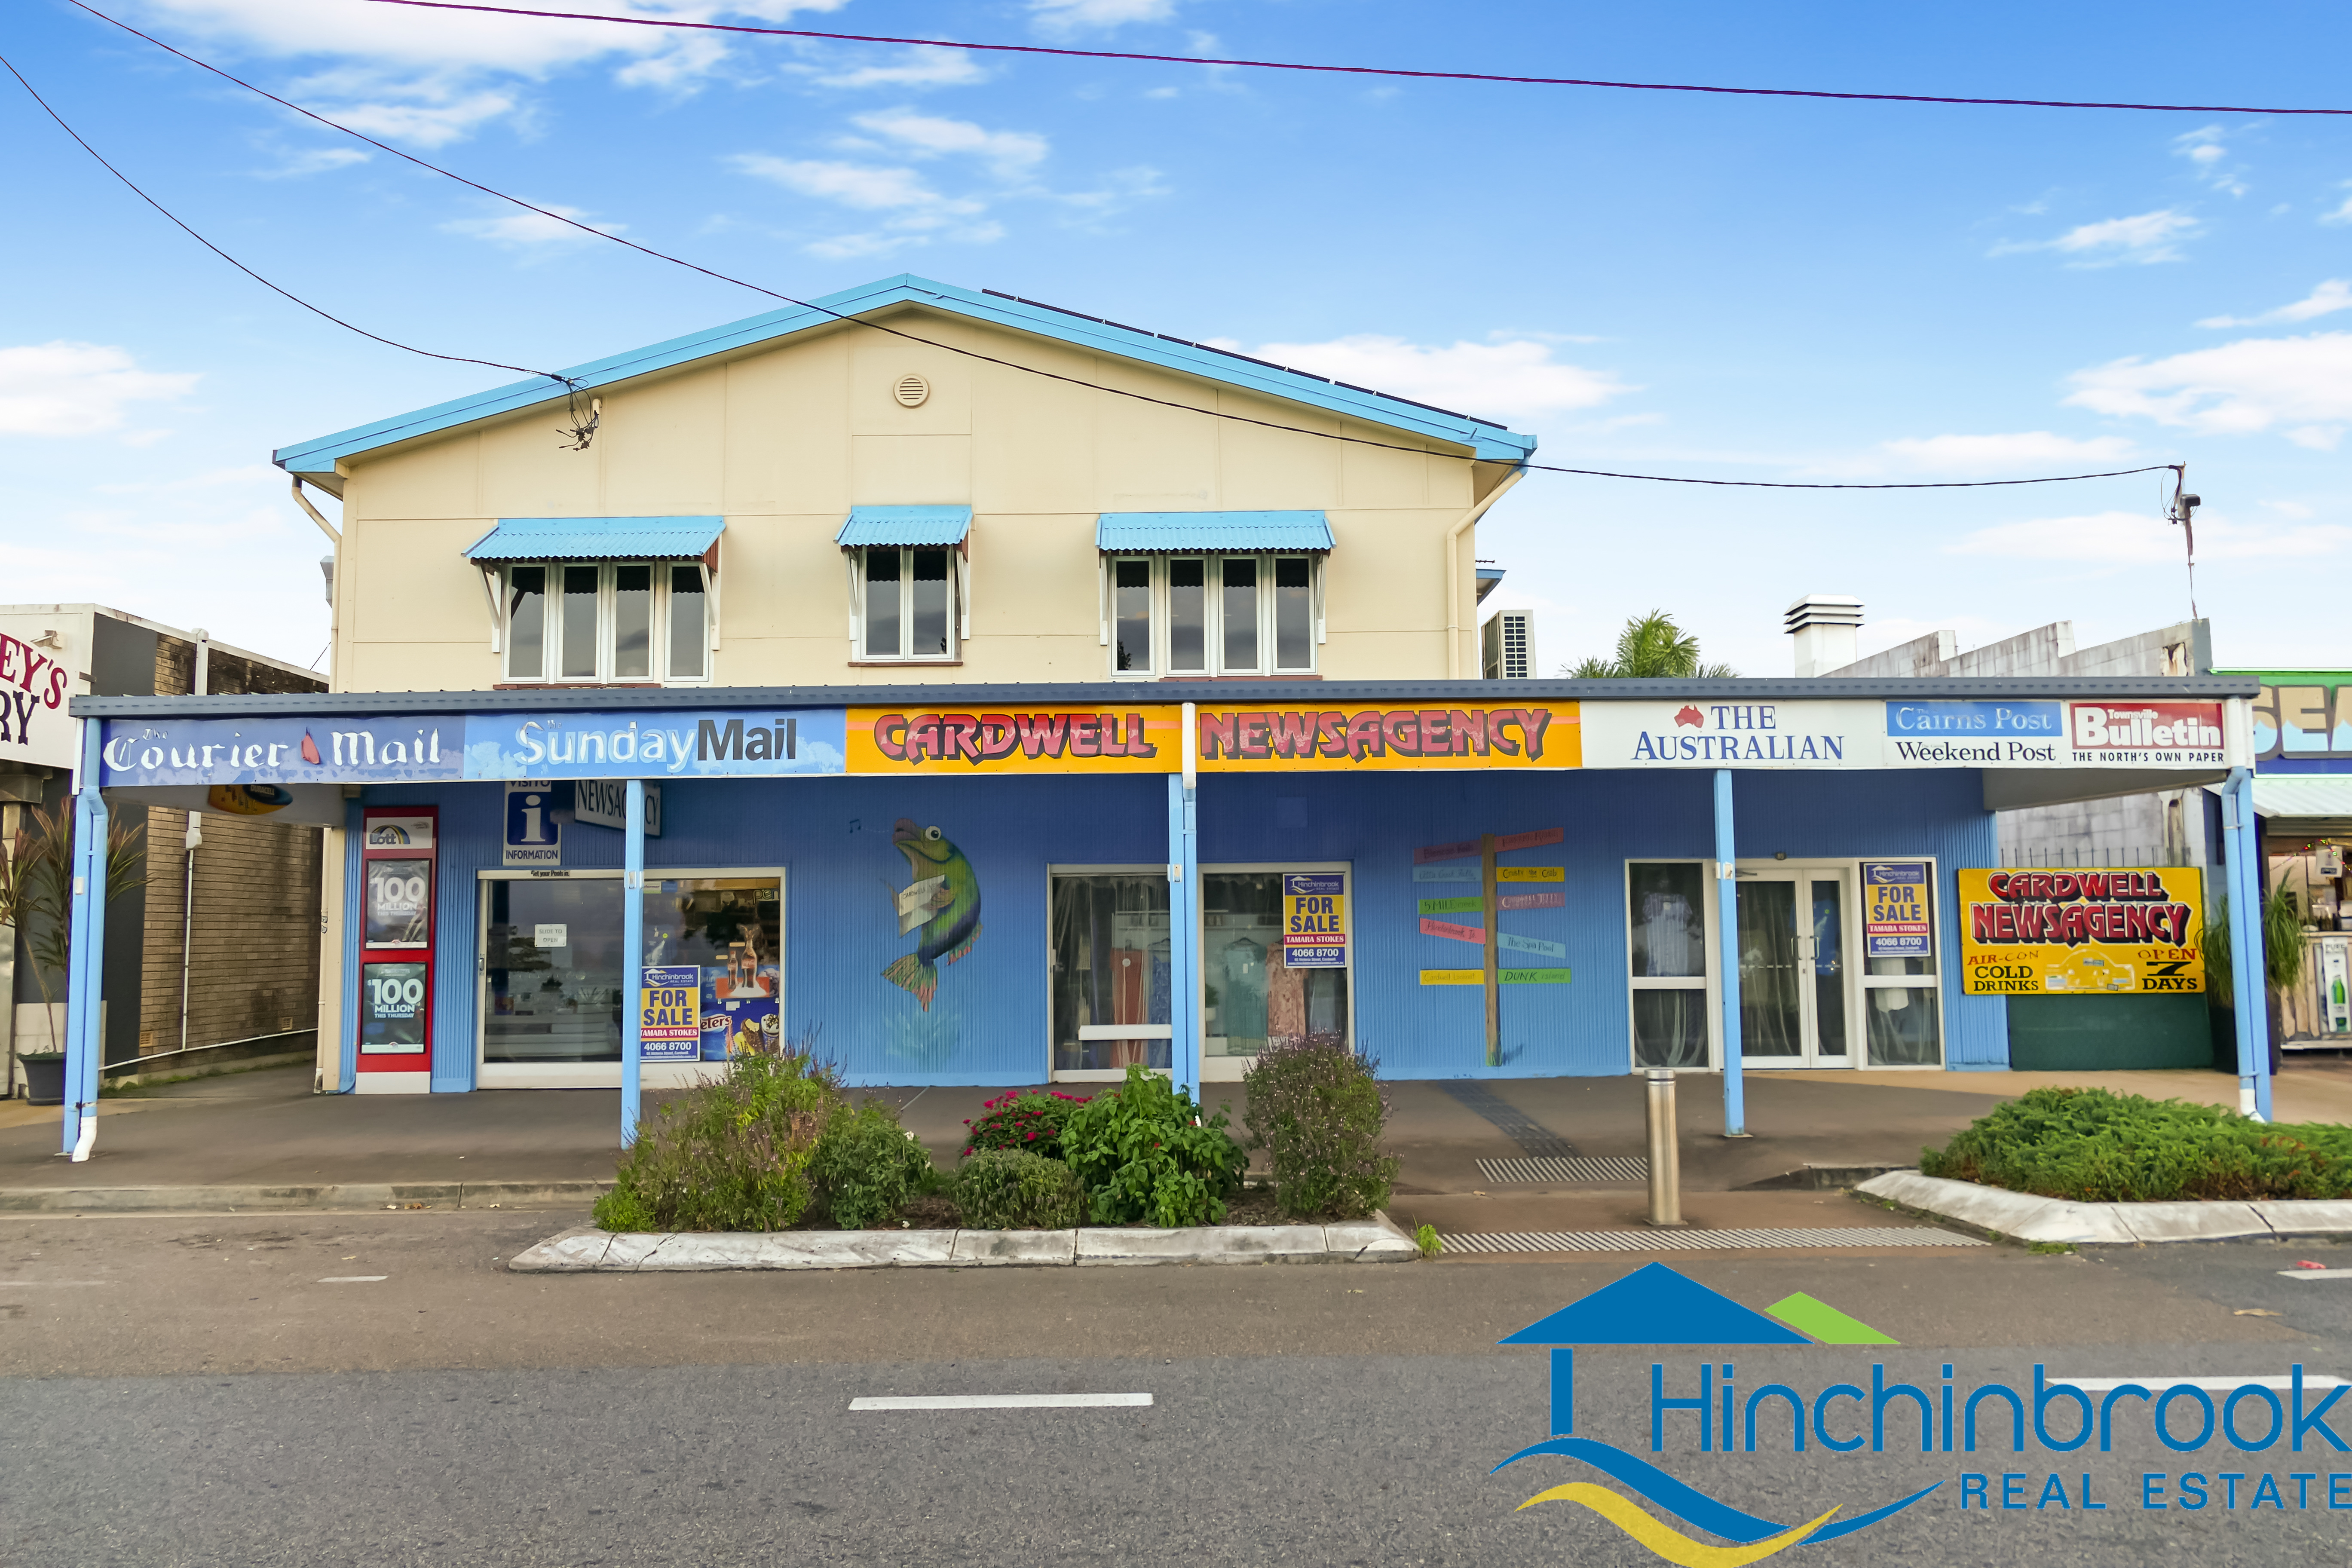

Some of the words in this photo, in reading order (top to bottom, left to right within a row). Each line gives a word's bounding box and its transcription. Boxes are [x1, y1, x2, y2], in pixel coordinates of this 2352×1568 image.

[1711, 705, 1776, 729] THE
[1896, 707, 1986, 730] Cairns
[1994, 707, 2052, 729] Post
[2107, 709, 2159, 719] Townsville
[2075, 707, 2220, 747] Bulletin
[874, 713, 1158, 766] CARDWELL
[1200, 709, 1552, 764] NEWSAGENCY
[103, 732, 288, 772] Courier
[331, 728, 439, 766] Mail
[1630, 731, 1844, 760] AUSTRALIAN
[1895, 741, 2001, 761] Weekend
[2007, 742, 2056, 761] Post
[2072, 752, 2092, 761] THE
[2100, 752, 2148, 761] NORTH'S
[2156, 752, 2181, 761] OWN
[2189, 753, 2223, 762] PAPER
[251, 784, 275, 796] DURACELL
[506, 850, 558, 859] INFORMATION
[1989, 871, 2170, 903] CARDWELL
[1878, 886, 1915, 903] FOR
[1296, 897, 1333, 914] FOR
[1424, 901, 1430, 911] 5
[1433, 900, 1455, 910] MILE
[1874, 904, 1921, 922] SALE
[1290, 915, 1339, 933] SALE
[1970, 902, 2193, 948] NEWSAGENCY
[1507, 936, 1520, 947] The
[1876, 937, 1898, 946] 4066
[1900, 937, 1922, 946] 8700
[1292, 949, 1314, 957] 4066
[1316, 949, 1339, 957] 8700
[1967, 950, 2040, 965] AIR-CON
[2138, 948, 2199, 960] OPEN
[1975, 966, 2033, 979] COLD
[2146, 961, 2192, 976] 7
[1424, 972, 1451, 981] Cardwell
[1504, 971, 1537, 981] DUNK
[1973, 980, 2039, 991] DRINKS
[2142, 978, 2198, 990] DAYS
[650, 990, 687, 1007] FOR
[374, 1004, 415, 1013] MILLION
[643, 1008, 692, 1026] SALE
[700, 1016, 732, 1029] eters
[644, 1042, 666, 1050] 4066
[669, 1042, 692, 1050] 8700
